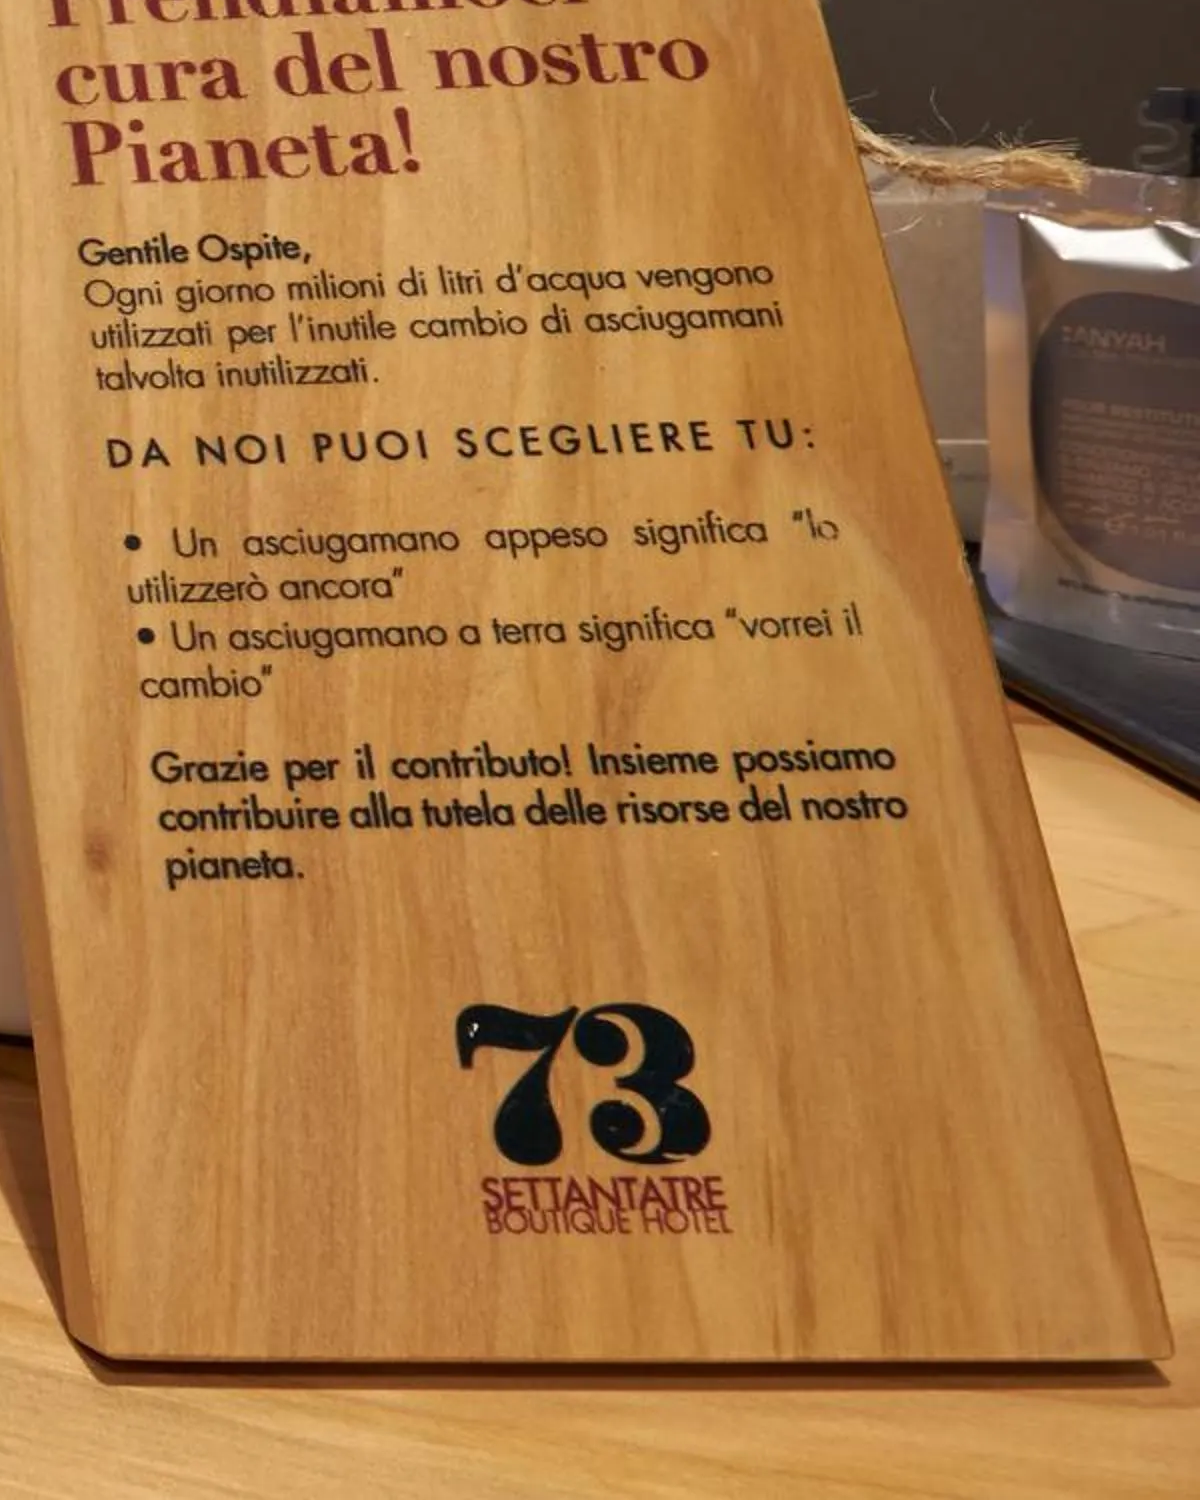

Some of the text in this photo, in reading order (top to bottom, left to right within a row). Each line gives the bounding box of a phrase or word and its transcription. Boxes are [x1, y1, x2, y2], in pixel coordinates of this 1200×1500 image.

[55, 27, 709, 107] cura del nostro
[61, 106, 421, 187] Pianeta!
[76, 230, 313, 272] Gentile Ospite,
[83, 261, 775, 317] Ogni giorno milioni di litri d'acqua vengono
[90, 300, 784, 355] utilizzati per l'inutile cambio di asciugamani
[95, 352, 379, 392] talvolta inutilizzati.
[105, 417, 815, 470] DA NOI PUOI SCEGLIERE TU:
[171, 526, 219, 559] Un
[241, 527, 461, 565] asciugamano
[483, 525, 609, 561] appeso
[633, 509, 769, 556] significa
[126, 565, 404, 605] utilizzerò ancora"
[169, 601, 863, 661] Un asciugamano a terra significa "vorrei il
[139, 662, 273, 700] cambio"
[149, 738, 897, 793] Grazie per il contributo! Insieme possiamo
[157, 782, 910, 833] contribuire alla tutela delle risorse del nostro
[164, 846, 305, 892] pianeta.
[455, 1002, 712, 1167] 73
[480, 1174, 729, 1212] SETTANTATRE
[484, 1207, 734, 1235] BOUTIQUE HOTEL
